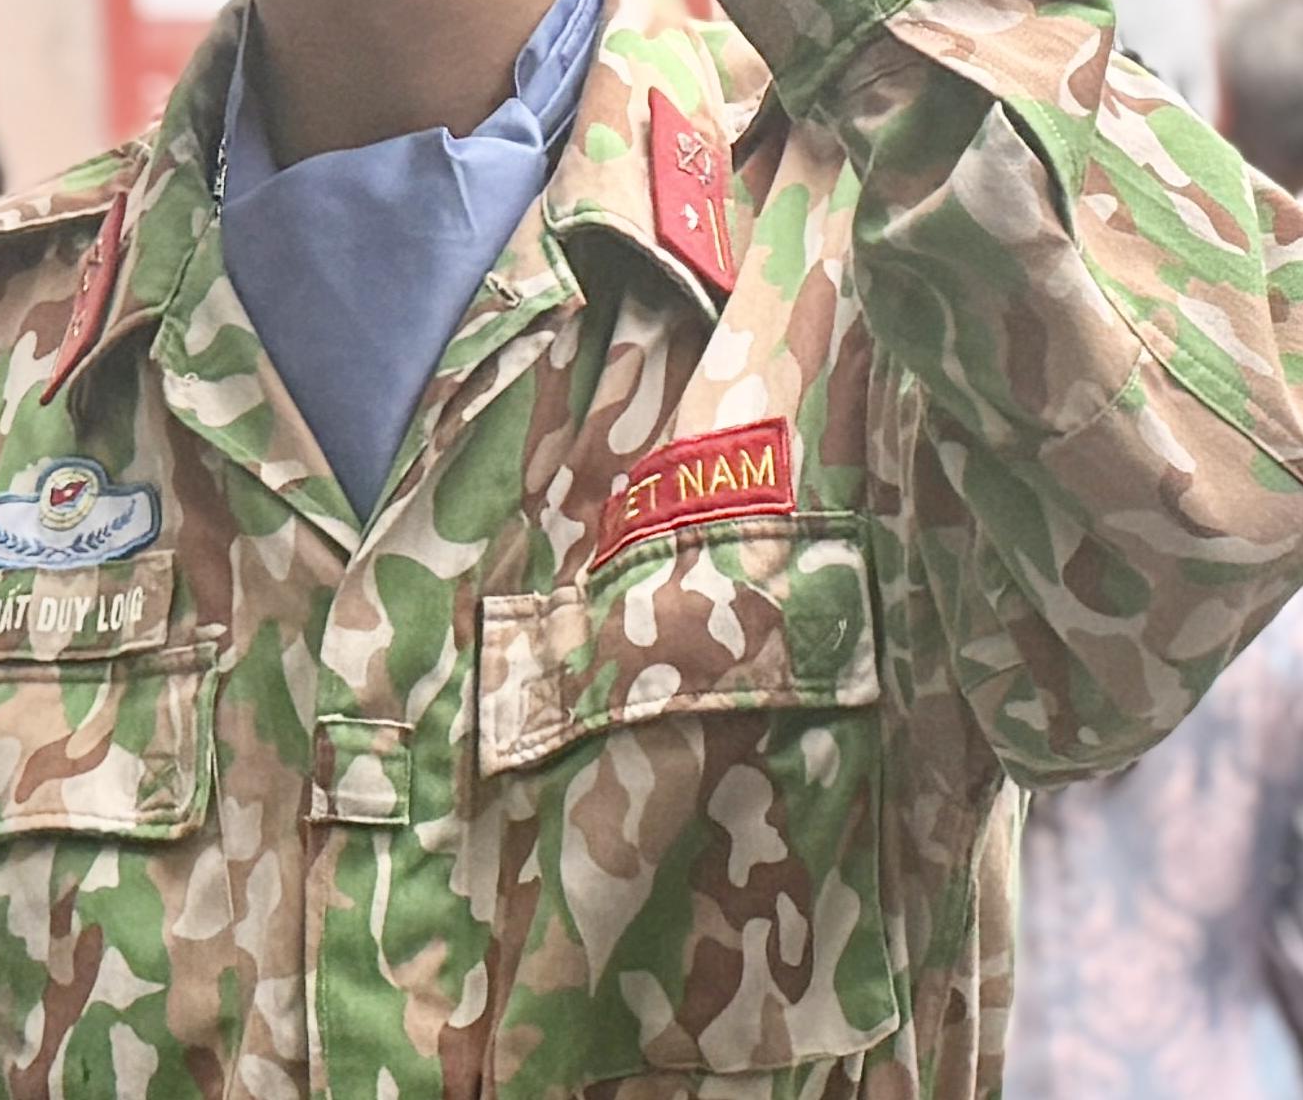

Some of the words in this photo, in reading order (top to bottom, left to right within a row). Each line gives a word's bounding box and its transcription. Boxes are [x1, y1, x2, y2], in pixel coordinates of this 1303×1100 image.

[624, 473, 662, 520] ET
[677, 445, 775, 501] NAM
[36, 596, 92, 633] DUY
